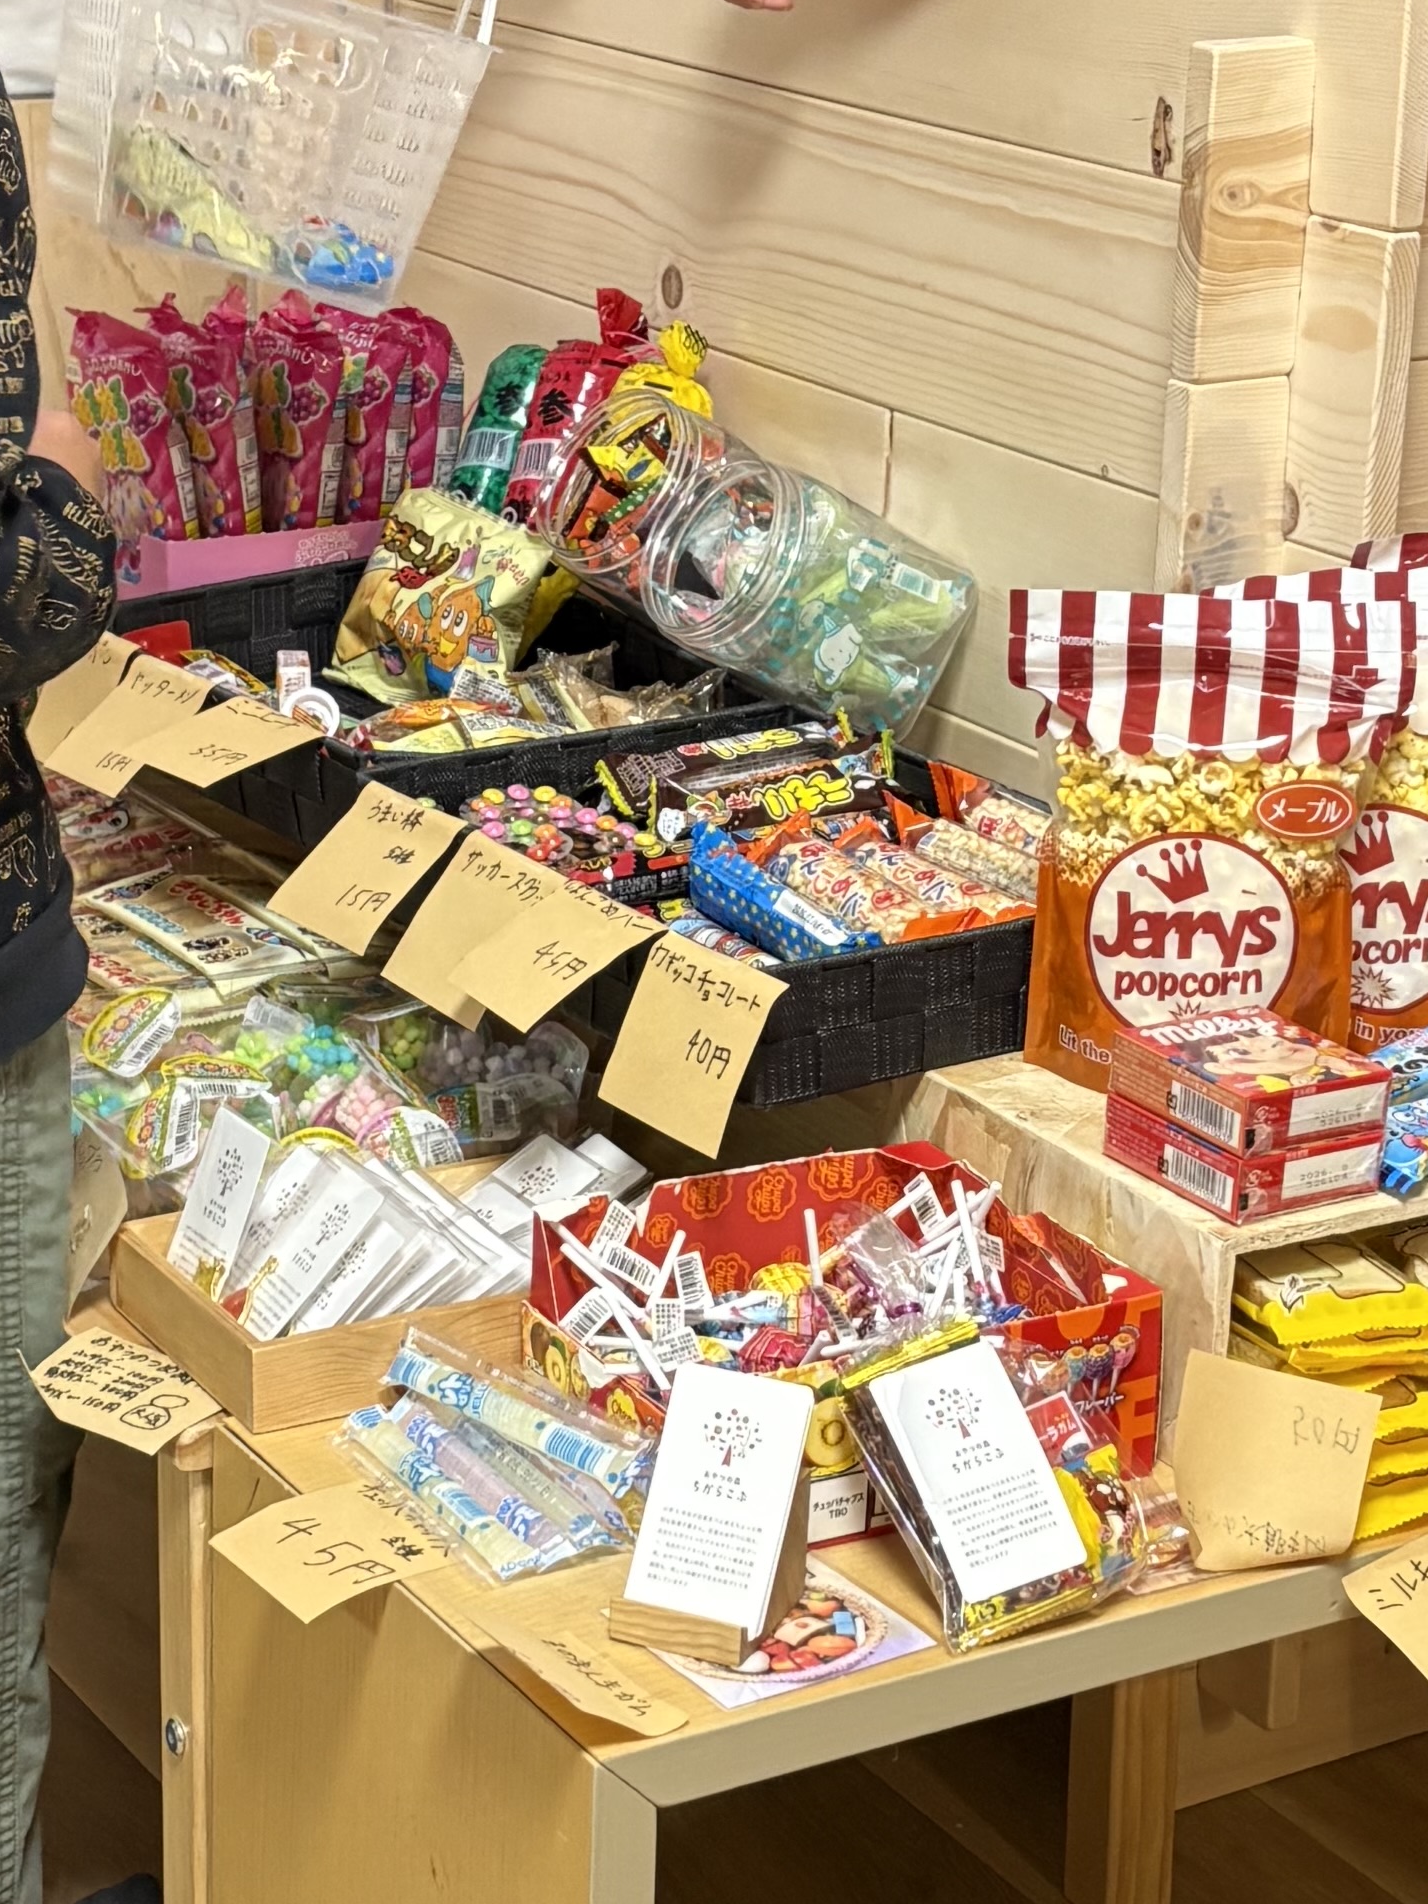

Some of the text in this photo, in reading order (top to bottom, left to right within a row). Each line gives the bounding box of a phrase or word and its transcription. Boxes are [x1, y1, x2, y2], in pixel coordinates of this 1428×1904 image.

[369, 799, 425, 833] うまい棒
[1269, 796, 1343, 824] メープル
[335, 883, 393, 913] 15円
[534, 940, 588, 980] 45円
[1114, 965, 1263, 1002] popcorn
[1354, 1016, 1375, 1043] in
[685, 1028, 732, 1080] 40円
[1080, 1038, 1112, 1065] the
[952, 1447, 1005, 1474] ちからこぶ
[693, 1480, 748, 1503] ちからこぶ
[276, 1517, 397, 1585] 45円
